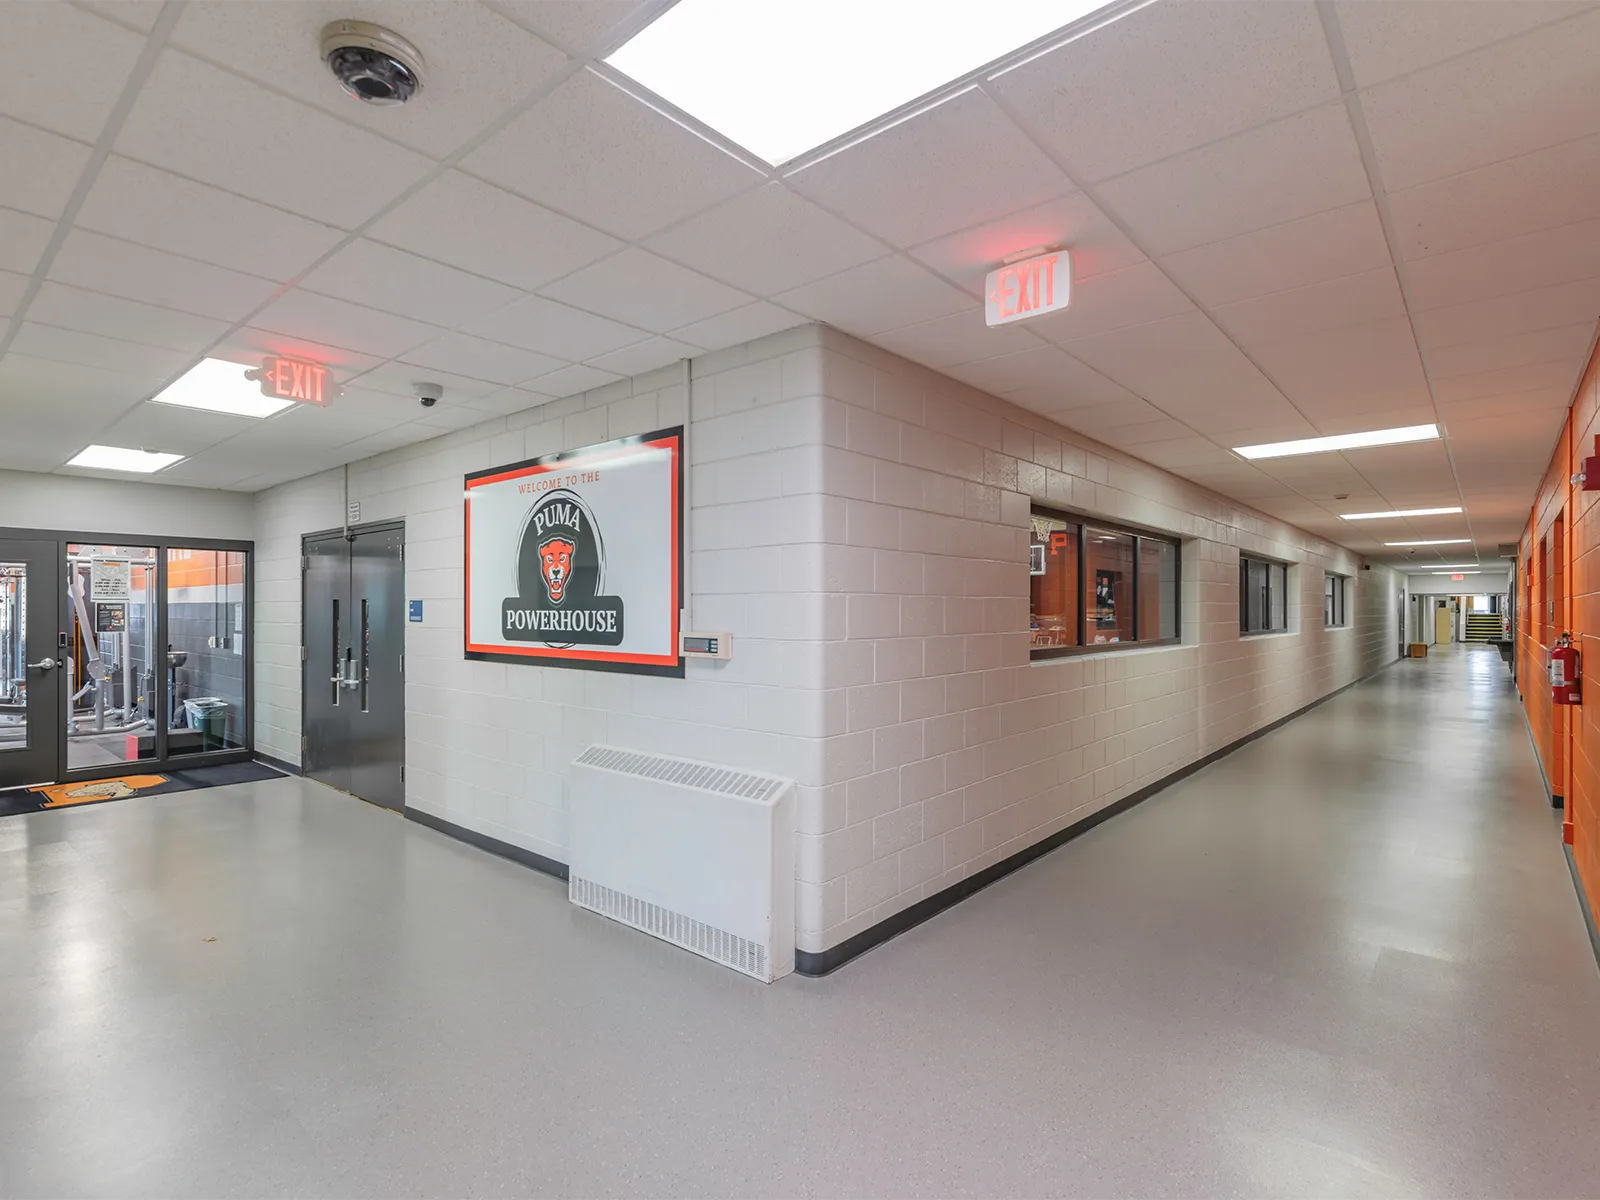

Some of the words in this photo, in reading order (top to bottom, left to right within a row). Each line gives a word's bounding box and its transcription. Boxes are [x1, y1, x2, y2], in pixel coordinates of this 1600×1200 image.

[997, 255, 1059, 319] EXIT
[275, 359, 326, 402] EXIT
[518, 478, 562, 494] WELCOME
[565, 475, 578, 487] TO
[581, 471, 600, 483] THE
[533, 503, 581, 536] PUMA
[506, 610, 617, 633] POWERHOUSE
